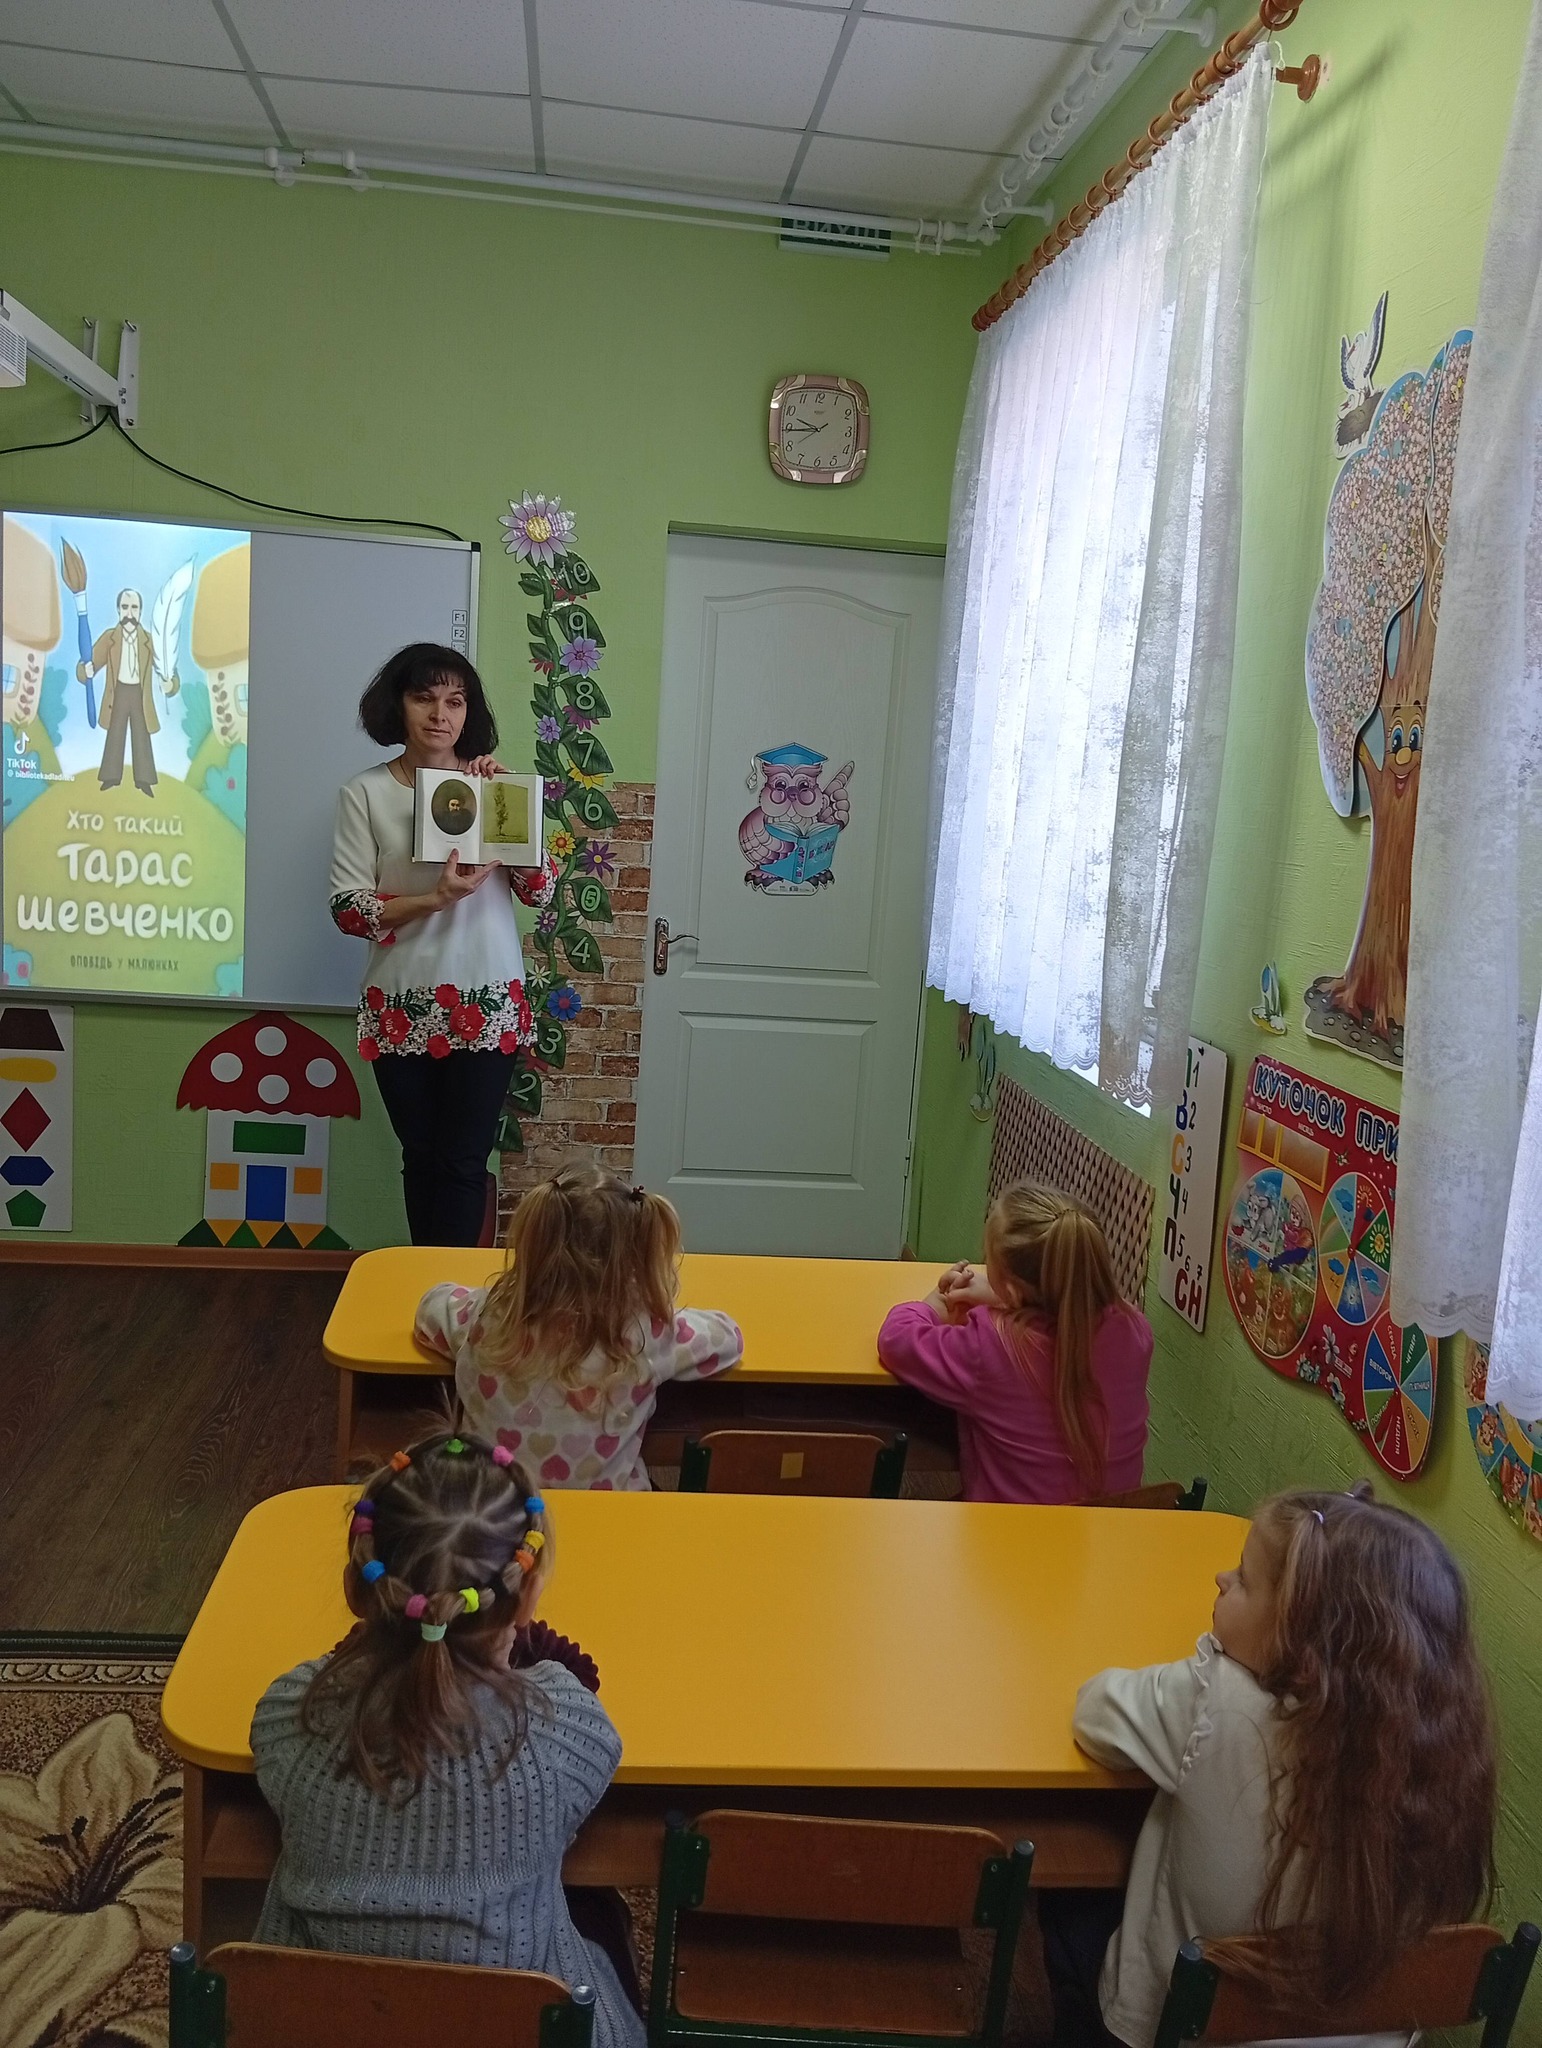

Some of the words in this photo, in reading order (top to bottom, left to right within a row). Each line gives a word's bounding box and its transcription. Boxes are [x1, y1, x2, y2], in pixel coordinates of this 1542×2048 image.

[786, 405, 796, 416] 10
[799, 393, 807, 404] 11
[815, 393, 825, 404] 12
[833, 395, 839, 406] 1
[844, 408, 852, 420] 2
[844, 426, 852, 438] 3
[785, 440, 794, 452] 8
[797, 453, 804, 466] 7
[842, 444, 850, 454] 4
[813, 456, 821, 467] 6
[829, 455, 838, 466] 5
[559, 561, 591, 590] 10
[454, 613, 465, 621] F1
[568, 611, 587, 641] 9
[454, 629, 465, 638] F2
[575, 681, 595, 711] 8
[7, 758, 37, 769] TikTok
[577, 738, 595, 768] 7
[583, 793, 603, 822] 6
[113, 815, 184, 837] такий
[57, 842, 194, 889] Тарас
[17, 894, 234, 942] Шевченко
[70, 955, 112, 969] ОПОВІДЬ
[118, 958, 123, 968] У
[128, 959, 179, 971] МАЛЮНКАХ
[571, 936, 591, 964] 4
[538, 1027, 563, 1054] 3
[511, 1073, 537, 1102] 2
[1193, 1061, 1200, 1088] 1
[1253, 1063, 1347, 1137] КУТОЧОК
[498, 1115, 509, 1142] 1
[1189, 1101, 1196, 1129] 2
[1171, 1133, 1185, 1175] С
[1184, 1146, 1192, 1172] 3
[1170, 1173, 1181, 1220] Ч
[1182, 1188, 1188, 1214] 4
[1164, 1217, 1177, 1261] П
[1177, 1234, 1185, 1257] 5
[1185, 1255, 1191, 1272] 6
[1387, 1325, 1397, 1360] СЕРЕДА
[1405, 1334, 1416, 1364] ЧЕТВЕР
